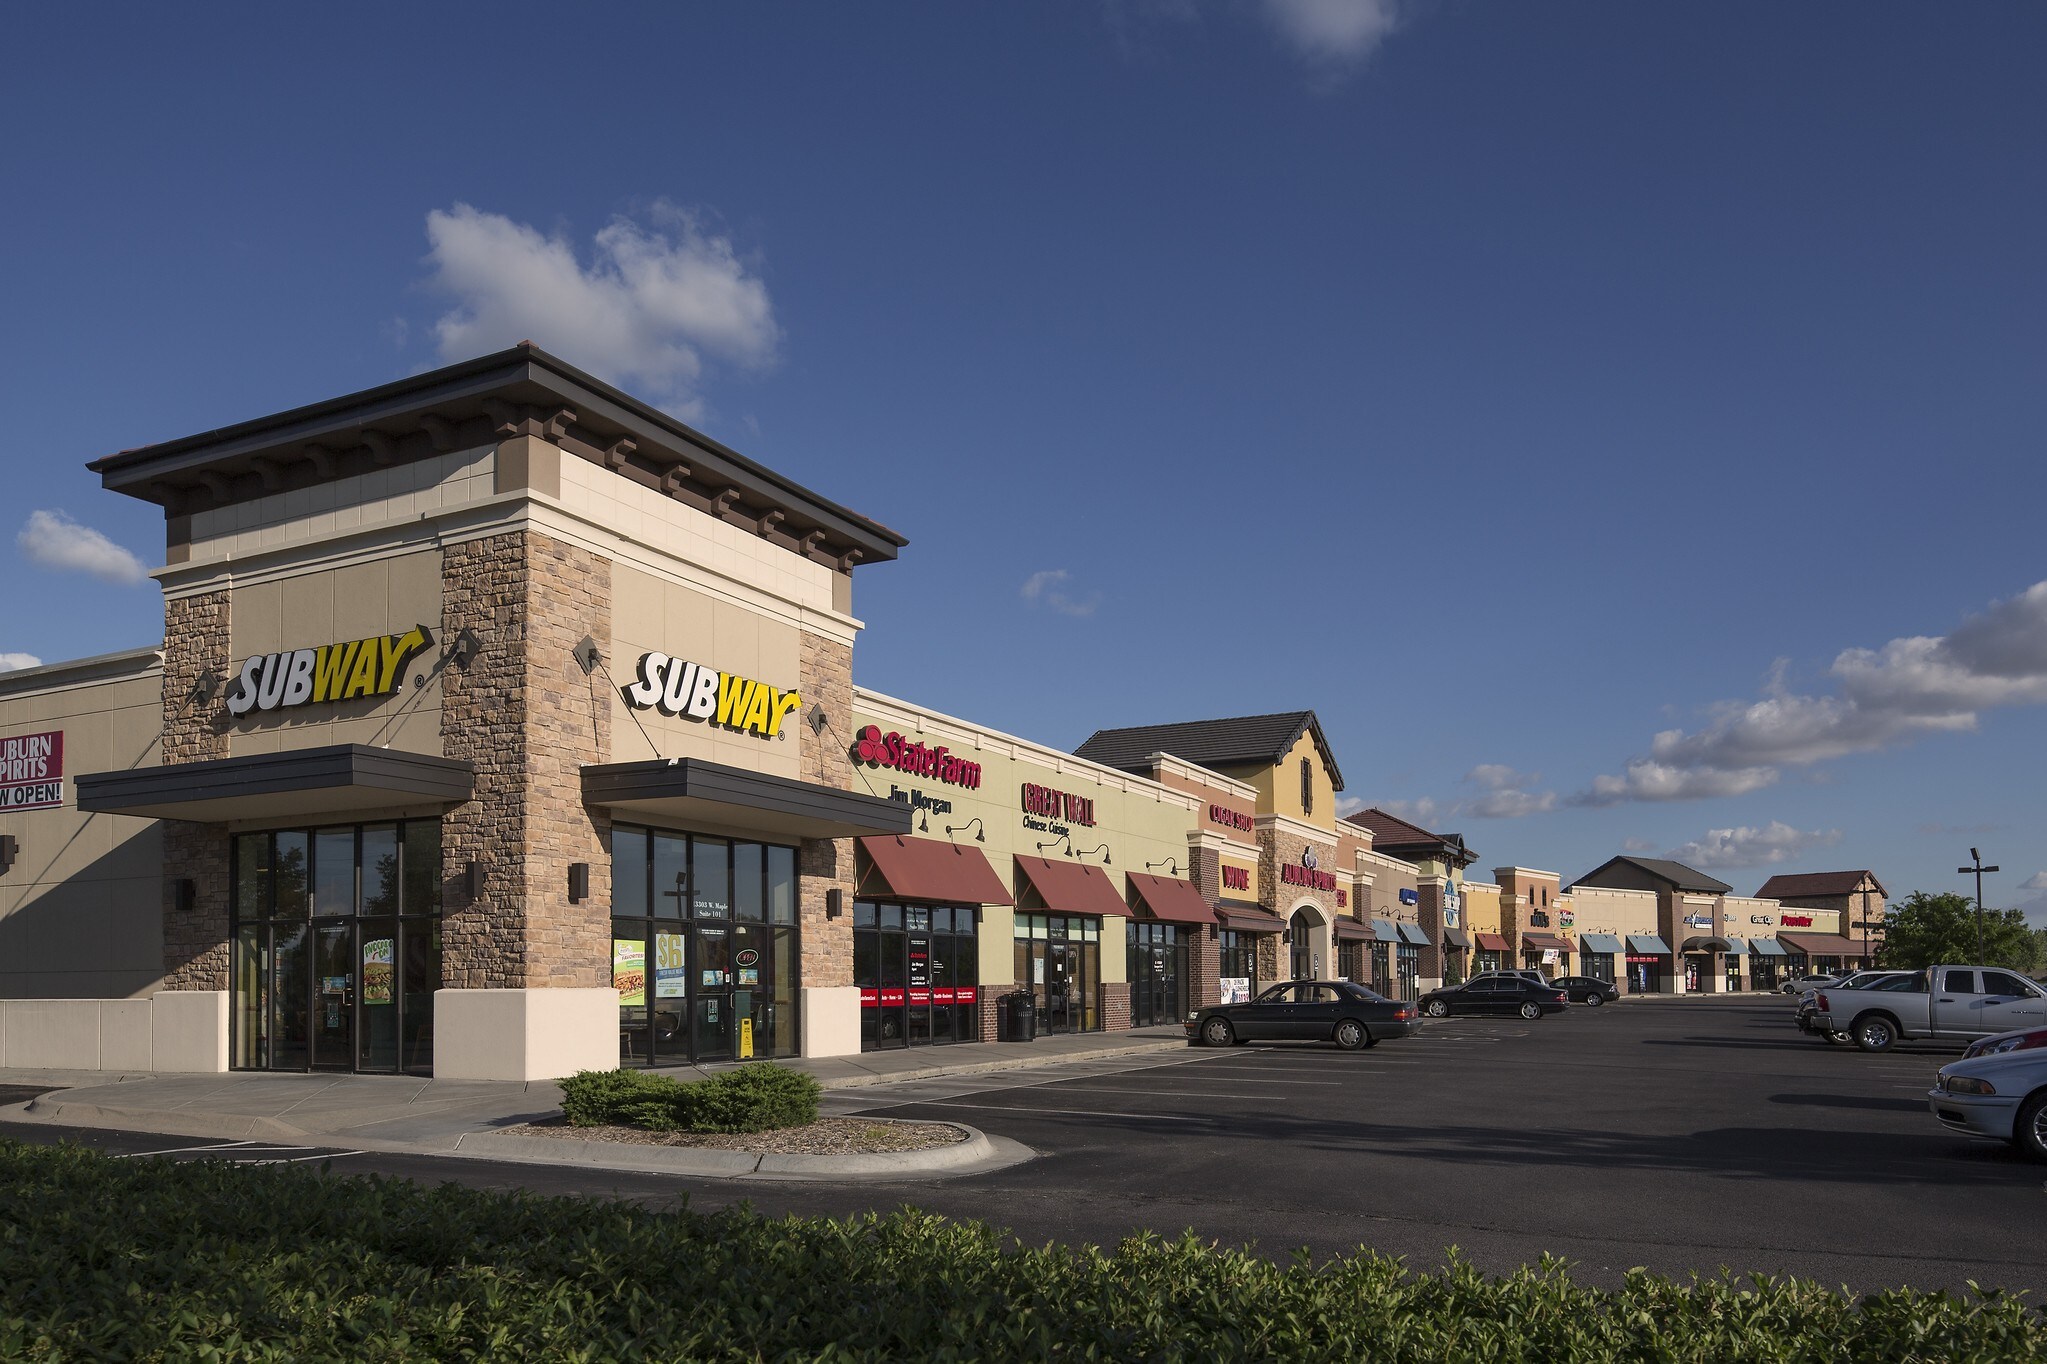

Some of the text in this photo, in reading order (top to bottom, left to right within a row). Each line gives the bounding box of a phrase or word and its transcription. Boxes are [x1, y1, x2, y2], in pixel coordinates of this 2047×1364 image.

[225, 623, 428, 718] SUBWAY
[621, 651, 802, 742] SUBWAY
[0, 734, 52, 761] UBURN
[0, 756, 47, 781] PIRITS
[14, 783, 60, 804] OPEN!
[888, 785, 952, 815] Jim Morgan
[1021, 782, 1097, 828] GREAT WALL
[1023, 815, 1069, 836] Chinese Cuisine
[1210, 804, 1254, 832] CIGAR SHOP
[1222, 865, 1250, 891] WINE
[1281, 863, 1336, 892] AUBURN SPIRITS
[715, 903, 728, 911] Maple
[1337, 889, 1347, 908] EER
[658, 934, 682, 969] $6
